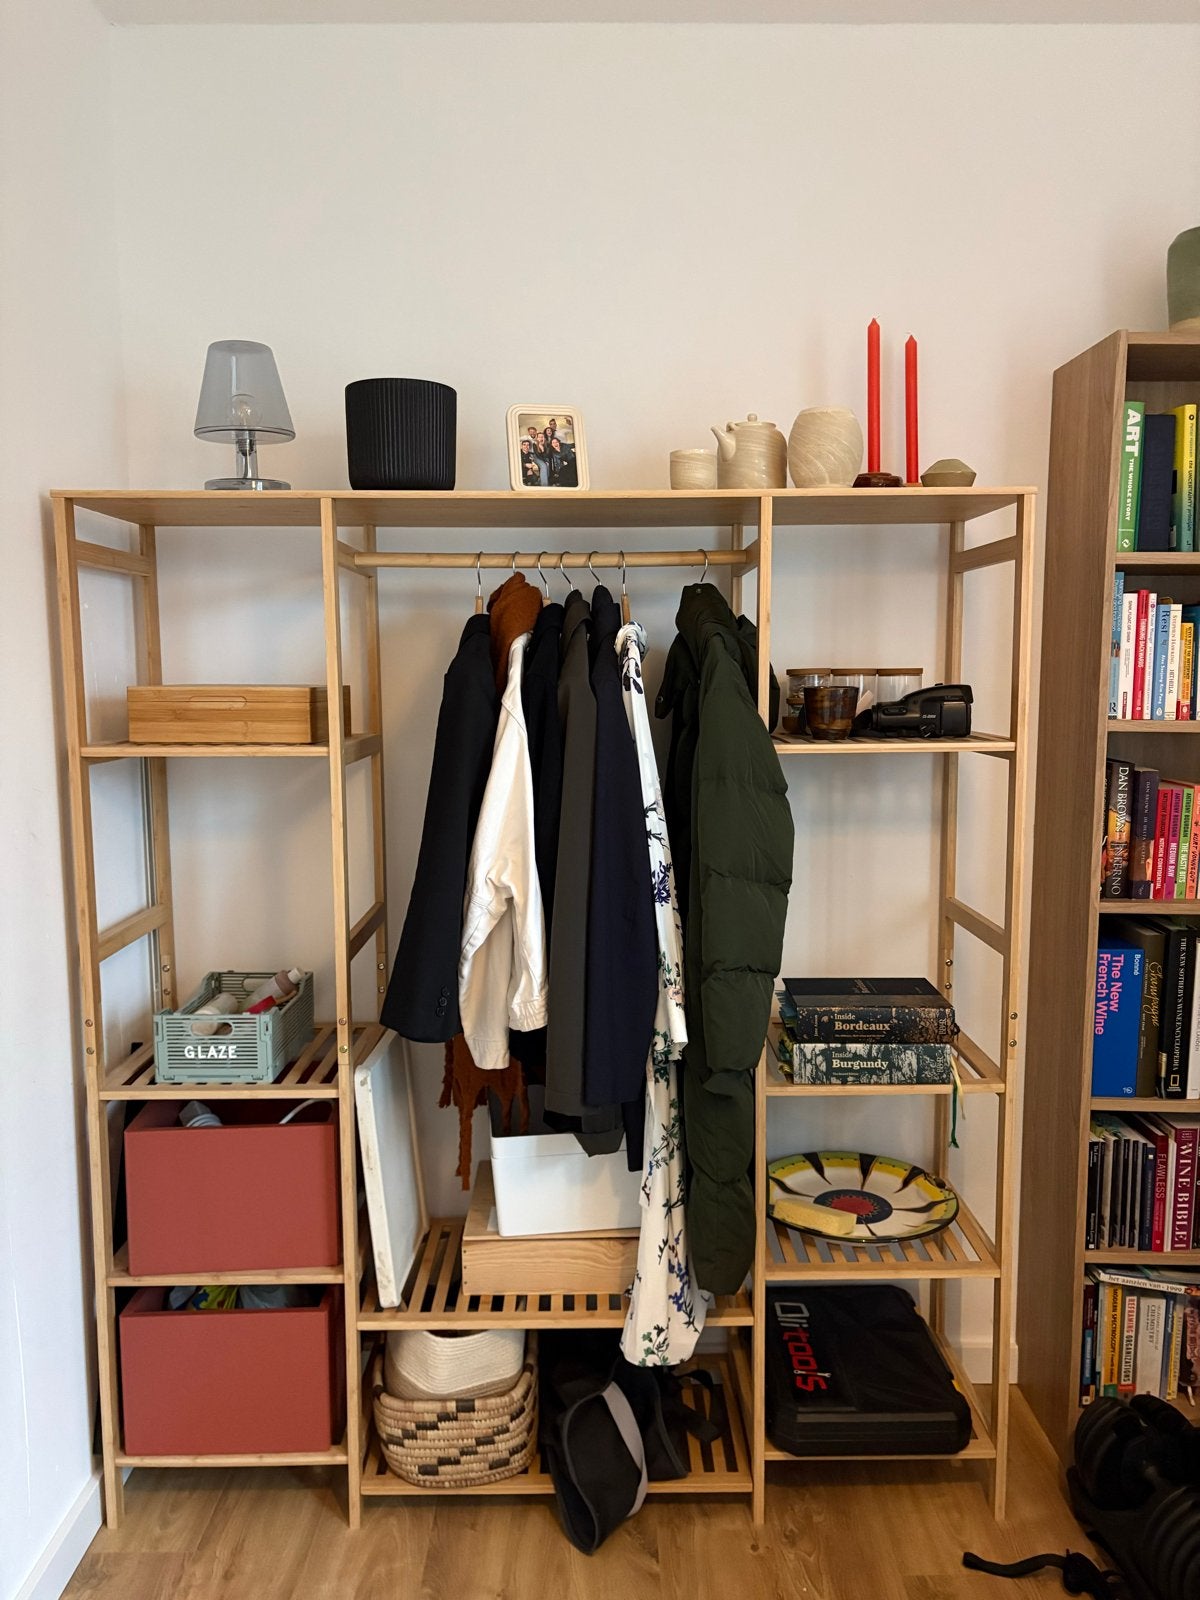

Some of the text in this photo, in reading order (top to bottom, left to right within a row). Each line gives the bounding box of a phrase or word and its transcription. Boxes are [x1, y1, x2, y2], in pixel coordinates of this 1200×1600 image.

[1125, 408, 1142, 457] ART
[1160, 610, 1170, 633] Rest
[1170, 614, 1178, 638] STEPHEN
[1138, 618, 1147, 668] THINKING BACKWARDS
[1169, 638, 1177, 664] HAWKING
[1173, 792, 1181, 813] ANTHONY
[1184, 792, 1192, 814] ANTHONY
[1110, 766, 1129, 895] DAN BROWN INFERNO
[1159, 814, 1167, 838] BOURDAIN
[1171, 814, 1179, 838] BOURDAIN
[1182, 814, 1191, 838] BOURDAIN
[1157, 837, 1165, 857] KITCHEN
[1169, 842, 1177, 865] MEDIUM
[1155, 858, 1163, 890] CONFIDENTIAL
[1189, 851, 1197, 883] VONNEGUT
[1133, 954, 1142, 976] Bonné
[1095, 954, 1111, 1035] French Wine
[1110, 954, 1124, 1012] The New
[1142, 961, 1163, 1027] Champagne
[1177, 968, 1185, 1003] SOTHEBY'S
[834, 1013, 856, 1021] Inside
[1175, 1003, 1183, 1022] WINE
[834, 1021, 891, 1031] Bordeaux
[184, 1045, 238, 1059] GLAZE
[1172, 1021, 1182, 1071] ENCYCLOPEDIA
[832, 1059, 889, 1070] Burgundy
[1155, 1153, 1167, 1199] FLAWLESS
[1178, 1143, 1193, 1188] WINE
[1174, 1192, 1190, 1242] BIBLE
[1121, 1278, 1147, 1287] aanzien
[1148, 1304, 1156, 1344] CHEMISTRY
[1123, 1298, 1135, 1382] REFRAMING ORGANIZATIONS
